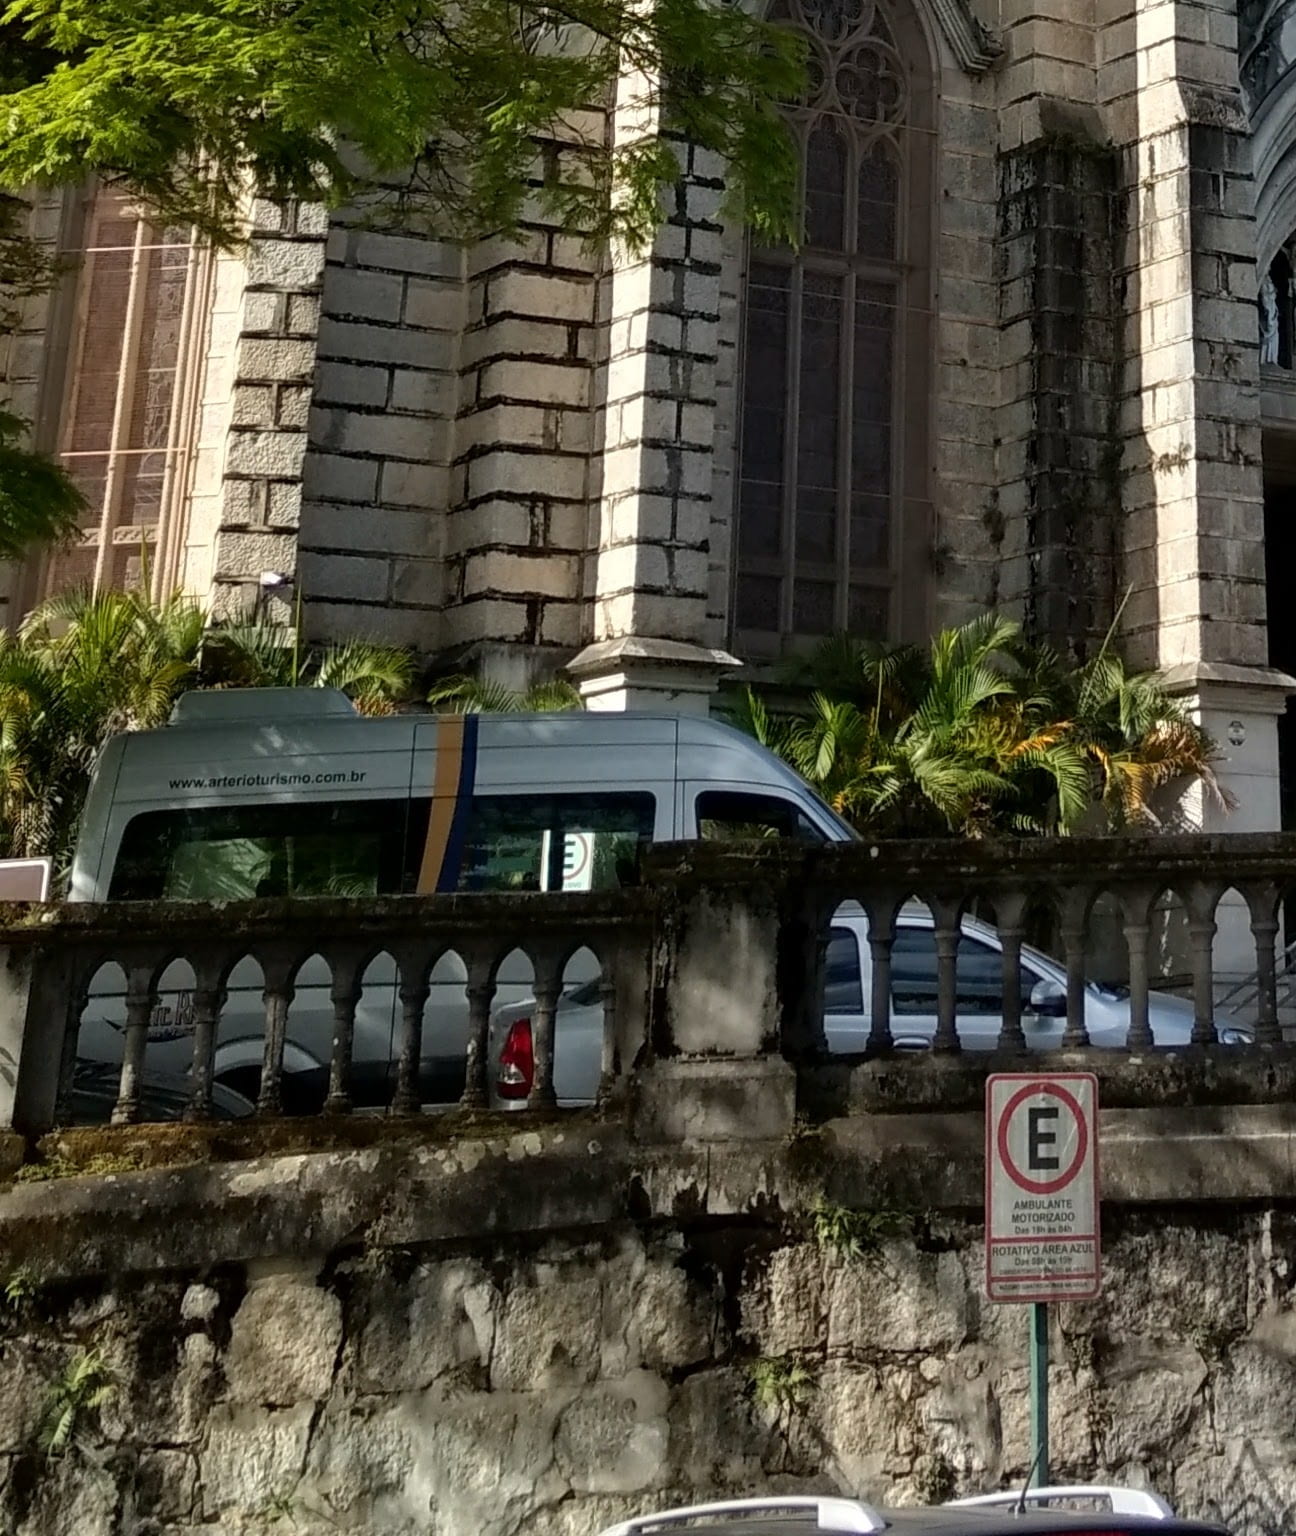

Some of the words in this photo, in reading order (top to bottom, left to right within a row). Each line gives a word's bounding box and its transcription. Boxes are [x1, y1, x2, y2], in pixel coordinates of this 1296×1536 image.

[169, 770, 367, 789] www.arterioturismo.com.br
[1028, 1107, 1060, 1170] E
[1013, 1199, 1073, 1210] AMBULANTE
[1011, 1212, 1076, 1223] MOTORIZADO
[1014, 1226, 1029, 1234] Das
[992, 1245, 1039, 1257] ROTATIVO
[1070, 1242, 1094, 1254] AZUL
